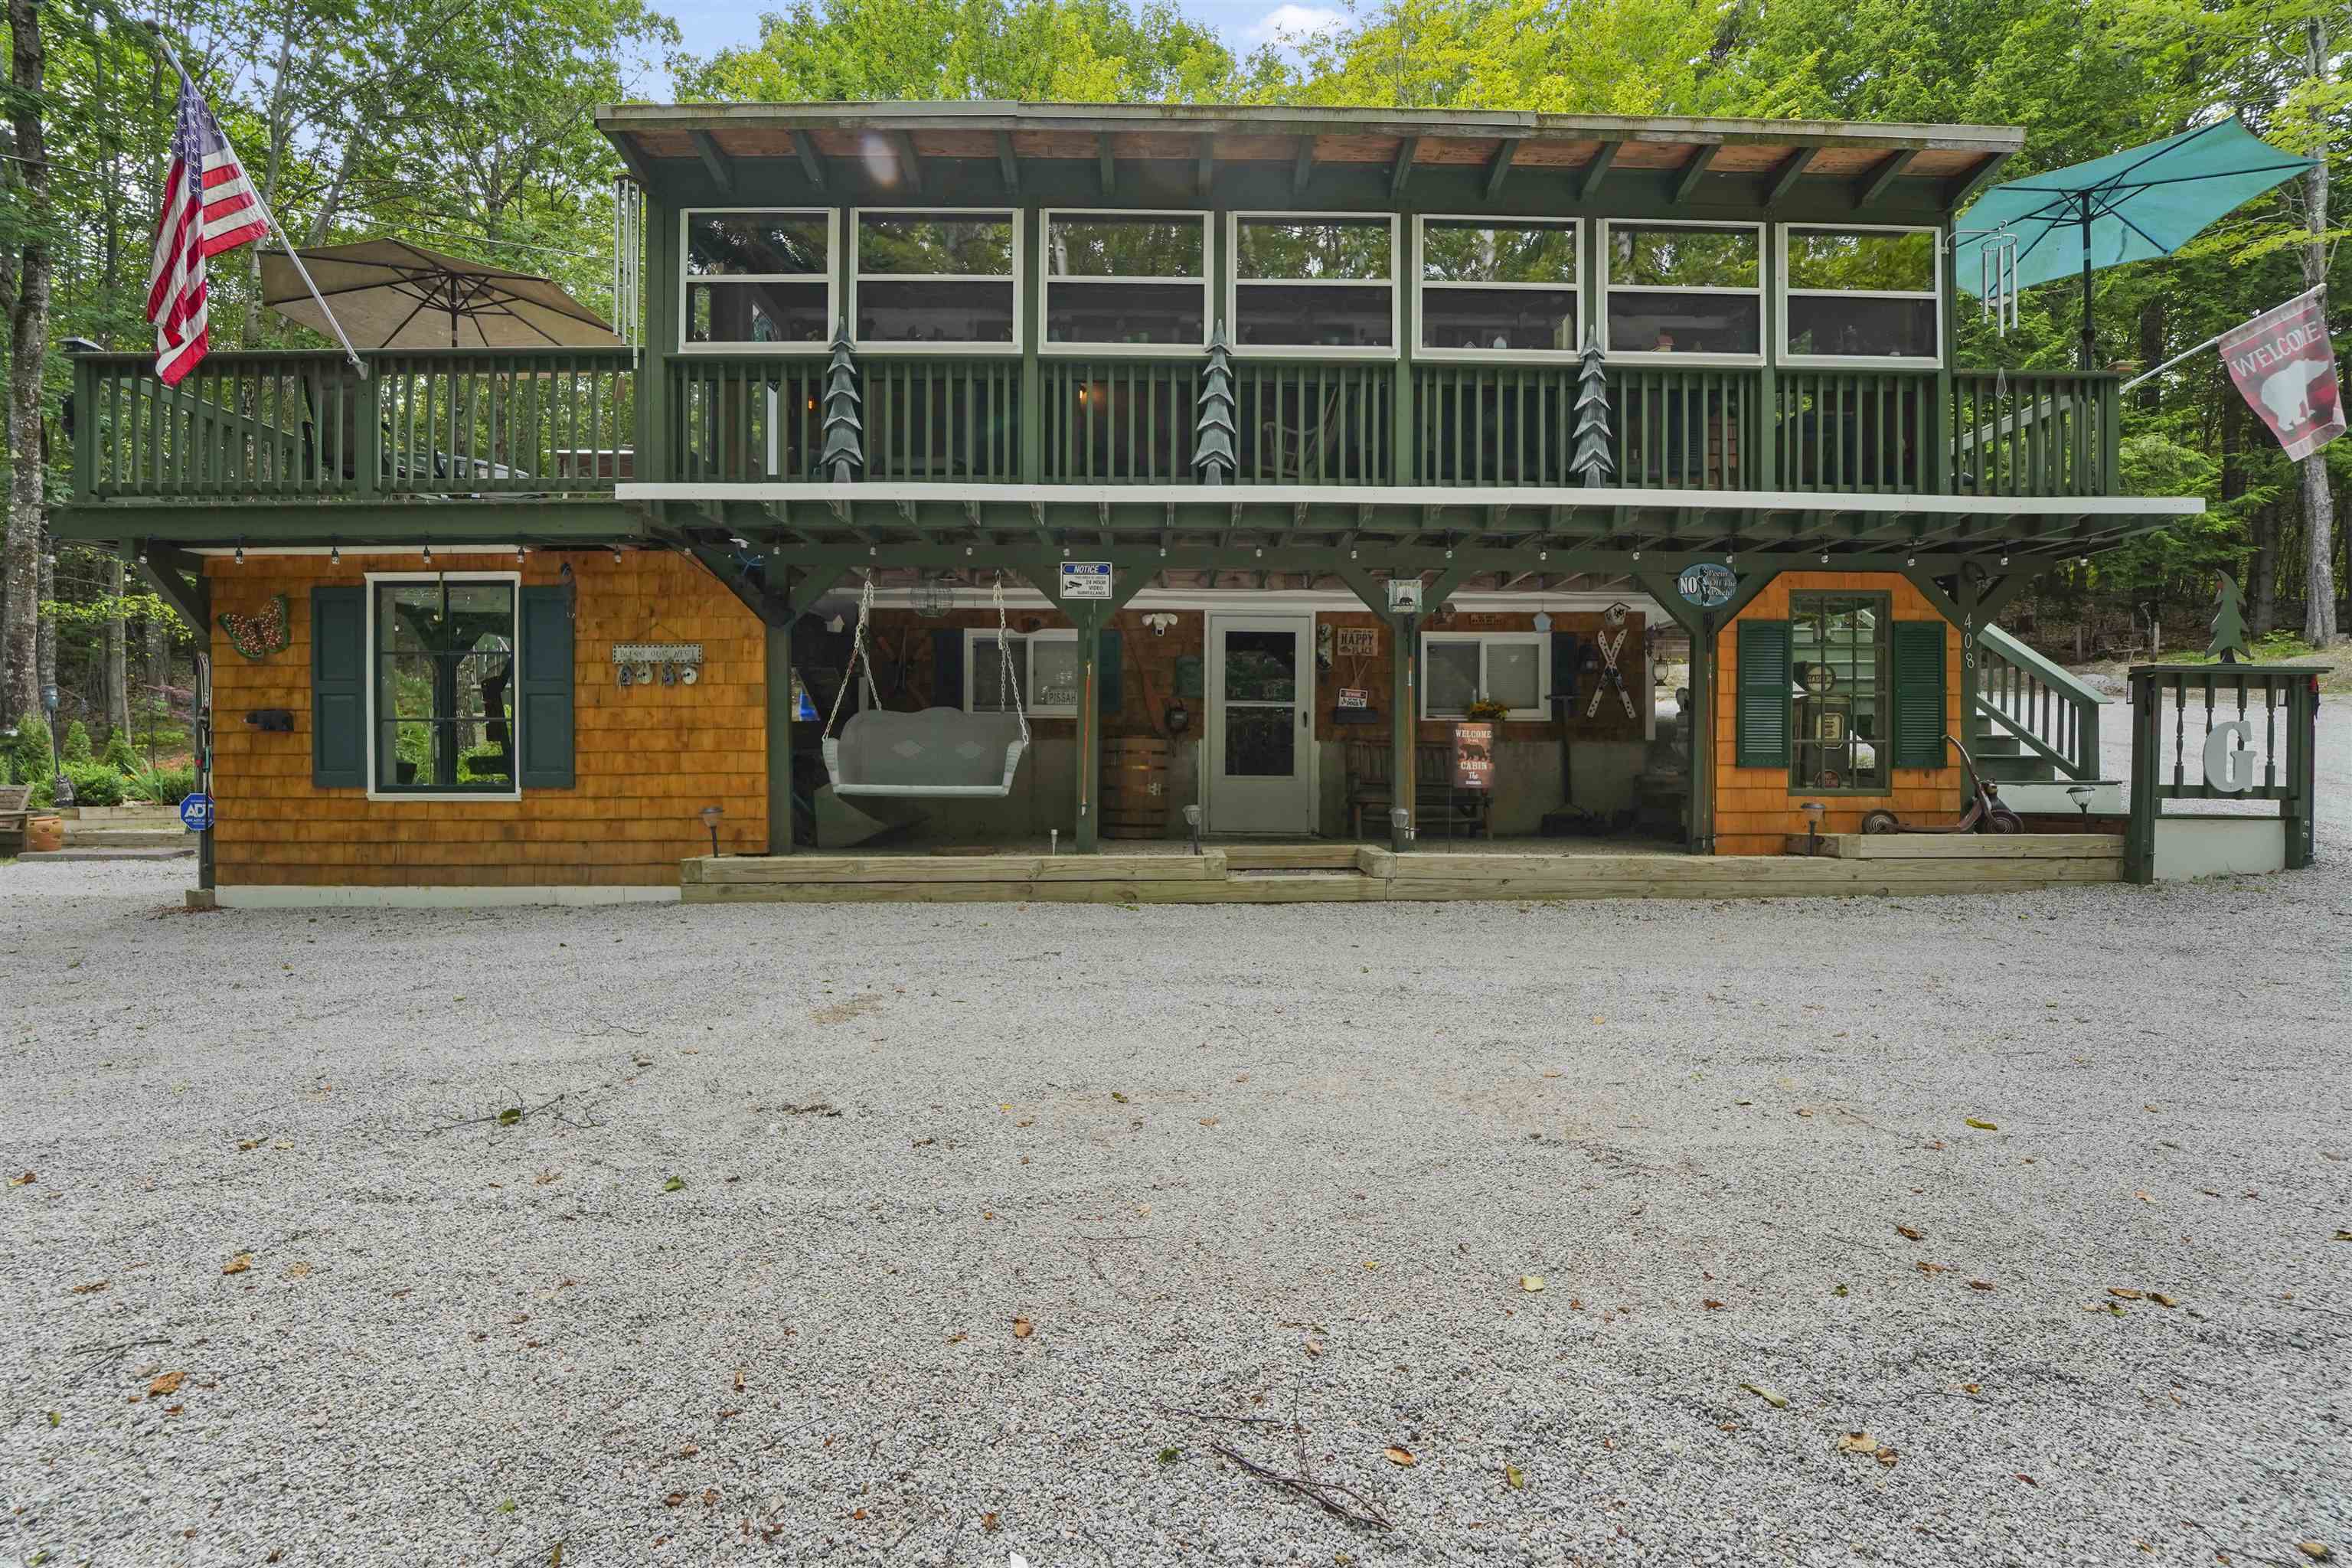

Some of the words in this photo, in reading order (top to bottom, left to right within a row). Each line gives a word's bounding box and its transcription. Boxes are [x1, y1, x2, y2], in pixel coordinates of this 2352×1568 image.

[1679, 577, 1697, 594] NO
[1341, 633, 1373, 645] HAPPY
[1965, 612, 1975, 668] 408
[1455, 729, 1492, 738] WELCOME
[2203, 720, 2257, 792] G
[1461, 761, 1487, 770] CABIN
